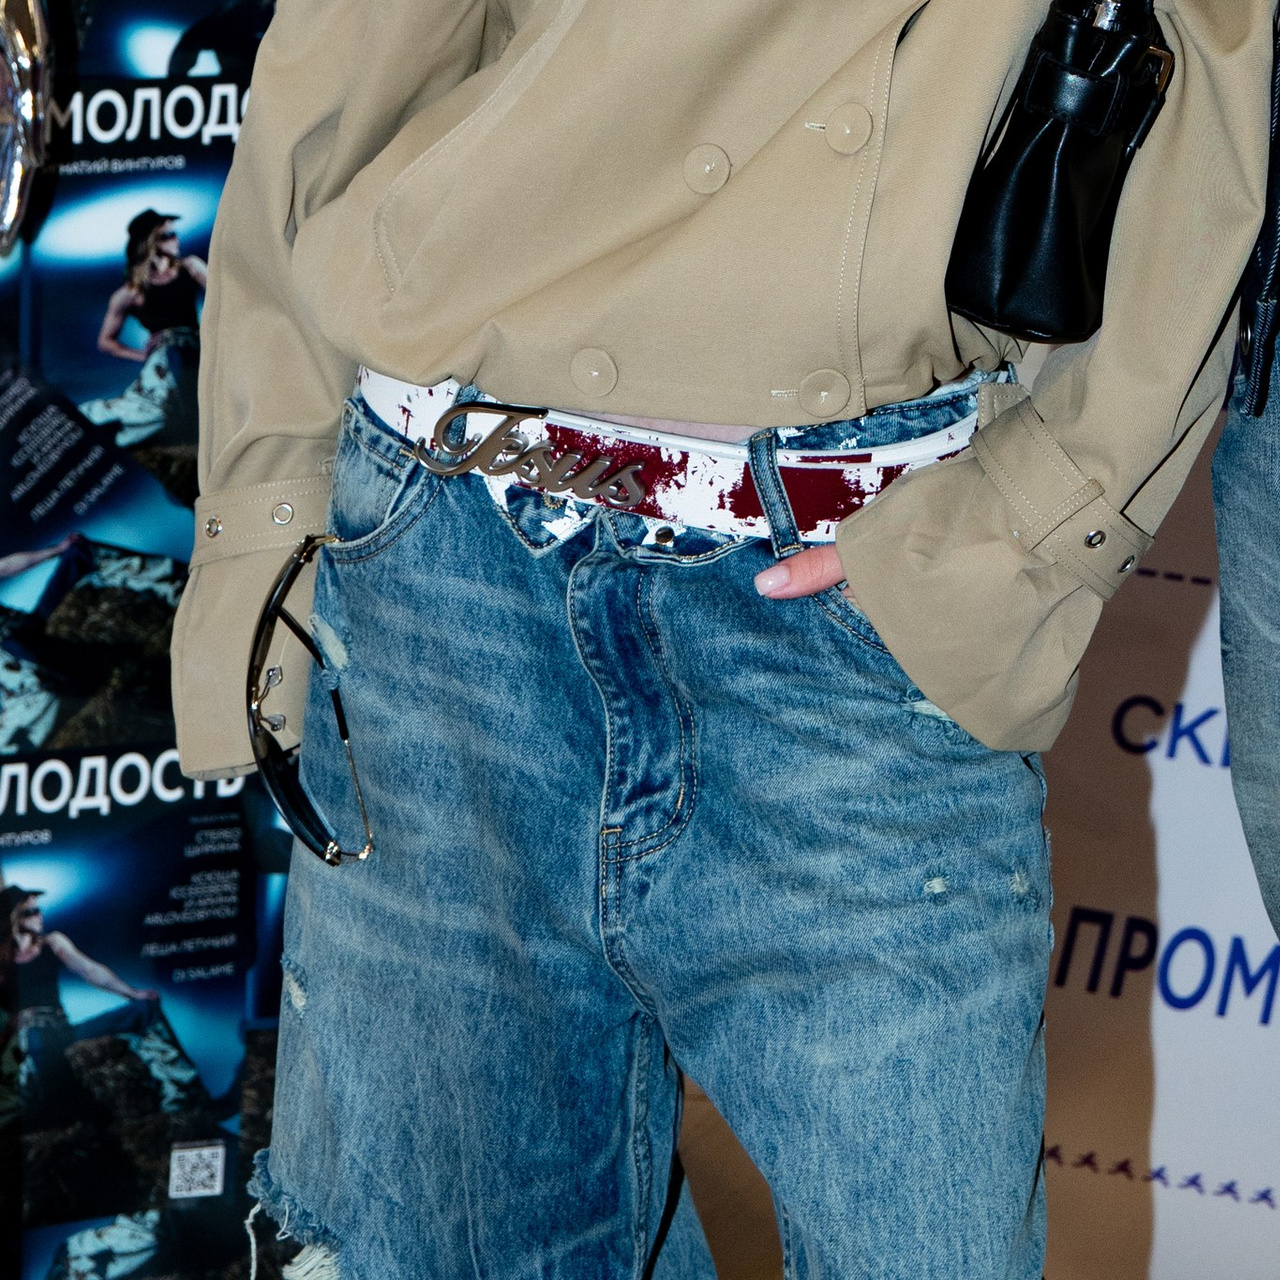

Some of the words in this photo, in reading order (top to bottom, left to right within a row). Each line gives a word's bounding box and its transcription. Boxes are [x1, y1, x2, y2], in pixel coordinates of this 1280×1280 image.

[44, 83, 251, 145] МОЛОД
[415, 401, 647, 507] Jesus
[1111, 694, 1230, 768] СК
[0, 749, 246, 819] ЛОДОС
